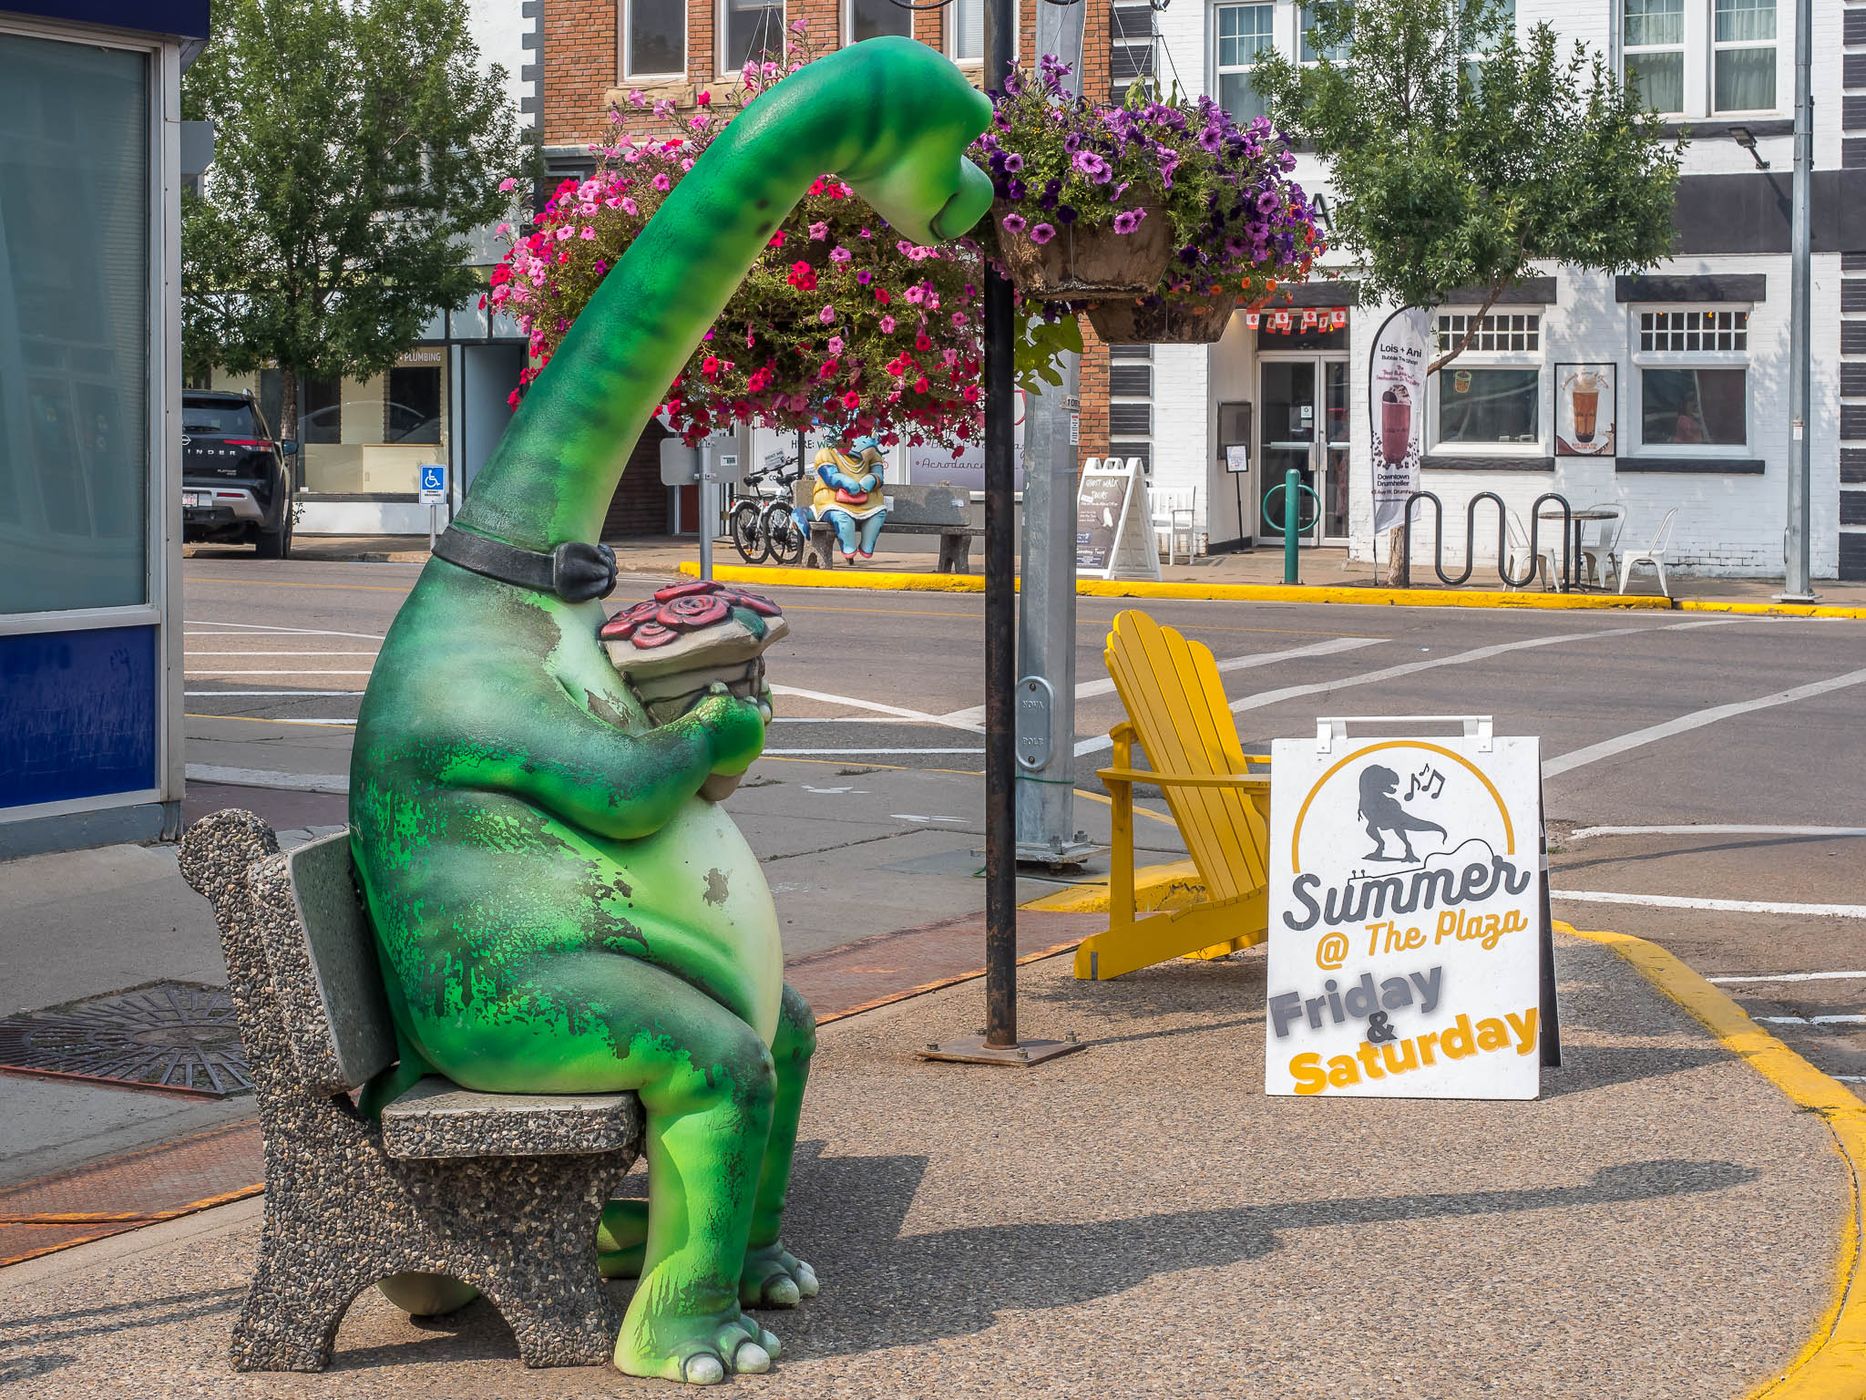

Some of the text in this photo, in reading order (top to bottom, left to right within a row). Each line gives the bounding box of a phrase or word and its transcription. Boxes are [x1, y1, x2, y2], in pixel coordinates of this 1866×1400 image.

[404, 352, 441, 362] PLUMBING
[1380, 343, 1399, 353] Lois
[1406, 347, 1422, 358] Ani
[1283, 856, 1531, 931] Summer
[1316, 908, 1528, 970] @ The Plaza
[1268, 966, 1442, 1038] Friday
[1366, 1010, 1398, 1043] &
[1288, 1007, 1538, 1095] Saturday
